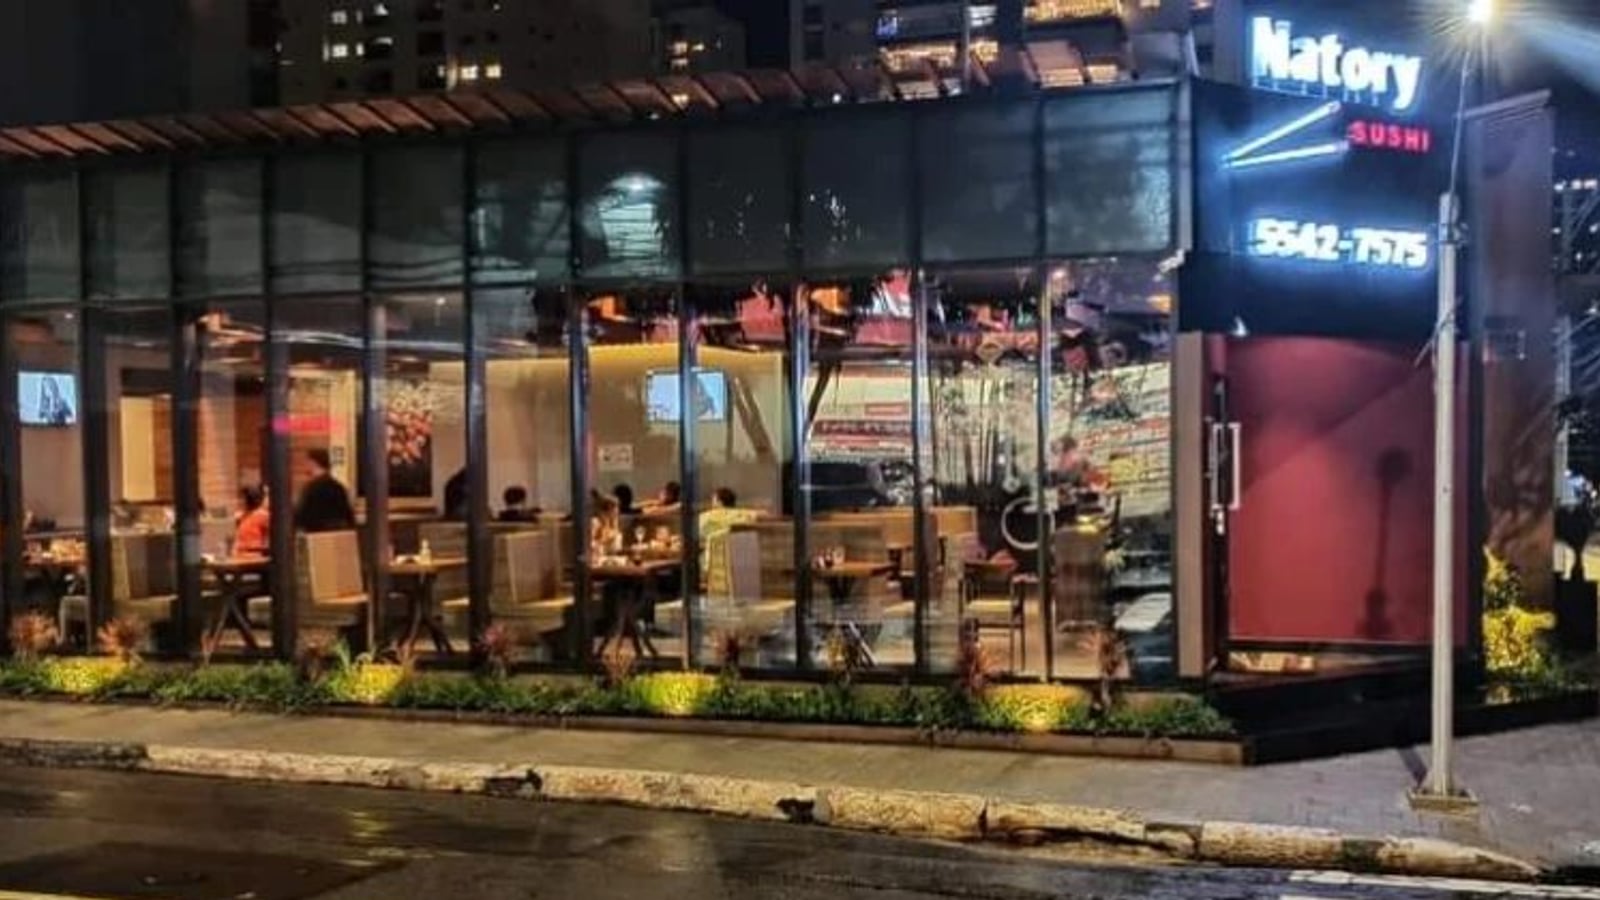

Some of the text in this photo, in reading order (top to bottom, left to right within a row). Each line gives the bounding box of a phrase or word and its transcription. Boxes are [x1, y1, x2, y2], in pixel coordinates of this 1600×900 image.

[1253, 17, 1421, 109] Natory
[1350, 120, 1430, 152] SUSHI
[1255, 218, 1428, 268] 5542-7575
